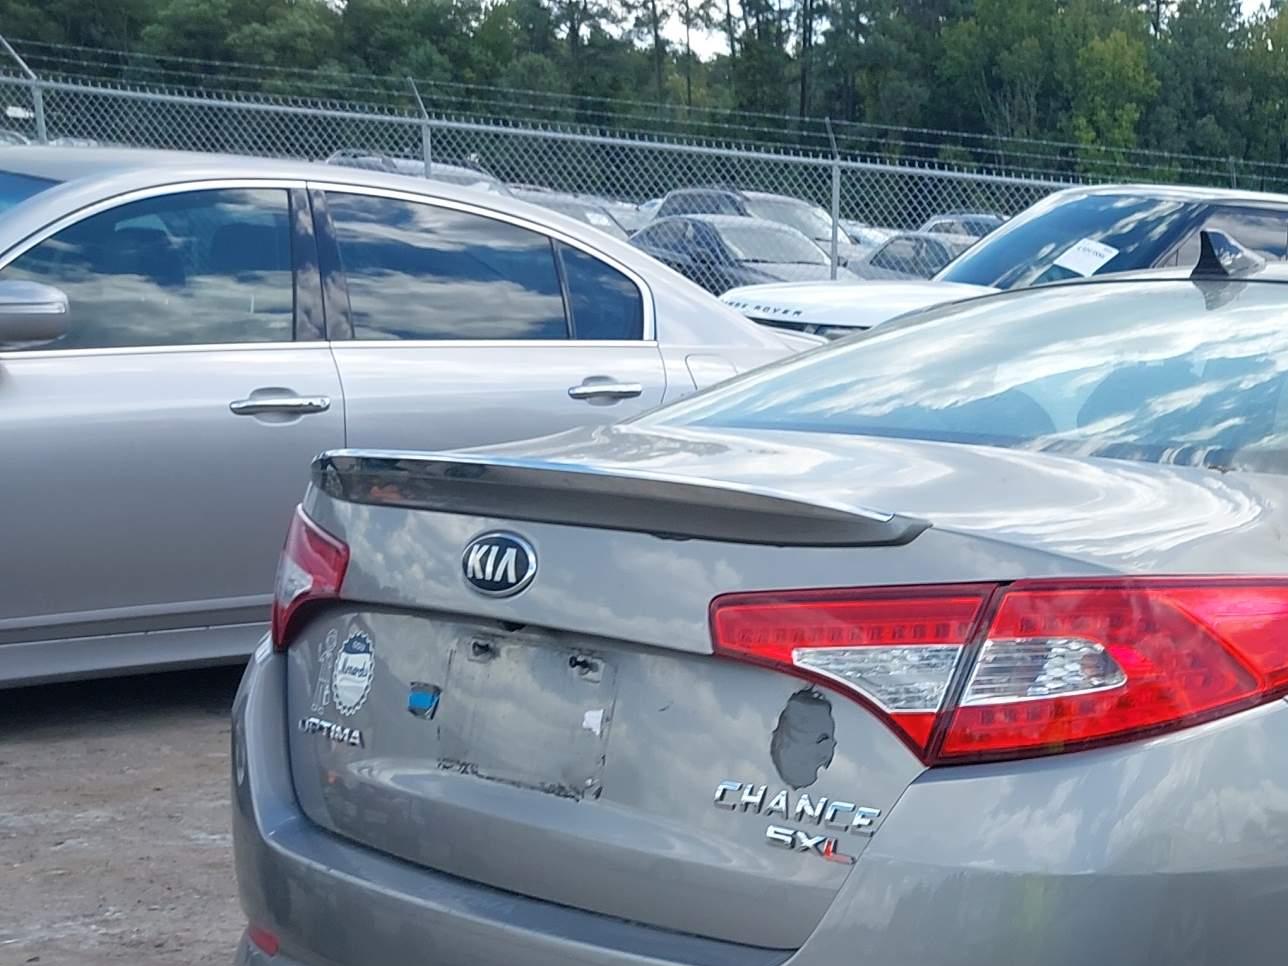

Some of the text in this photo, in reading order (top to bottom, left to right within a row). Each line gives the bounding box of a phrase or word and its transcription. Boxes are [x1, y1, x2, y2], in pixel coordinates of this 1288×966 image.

[753, 304, 803, 317] ROVER
[466, 543, 518, 584] KIA
[714, 779, 882, 838] CHANCE
[765, 824, 857, 866] SXL
